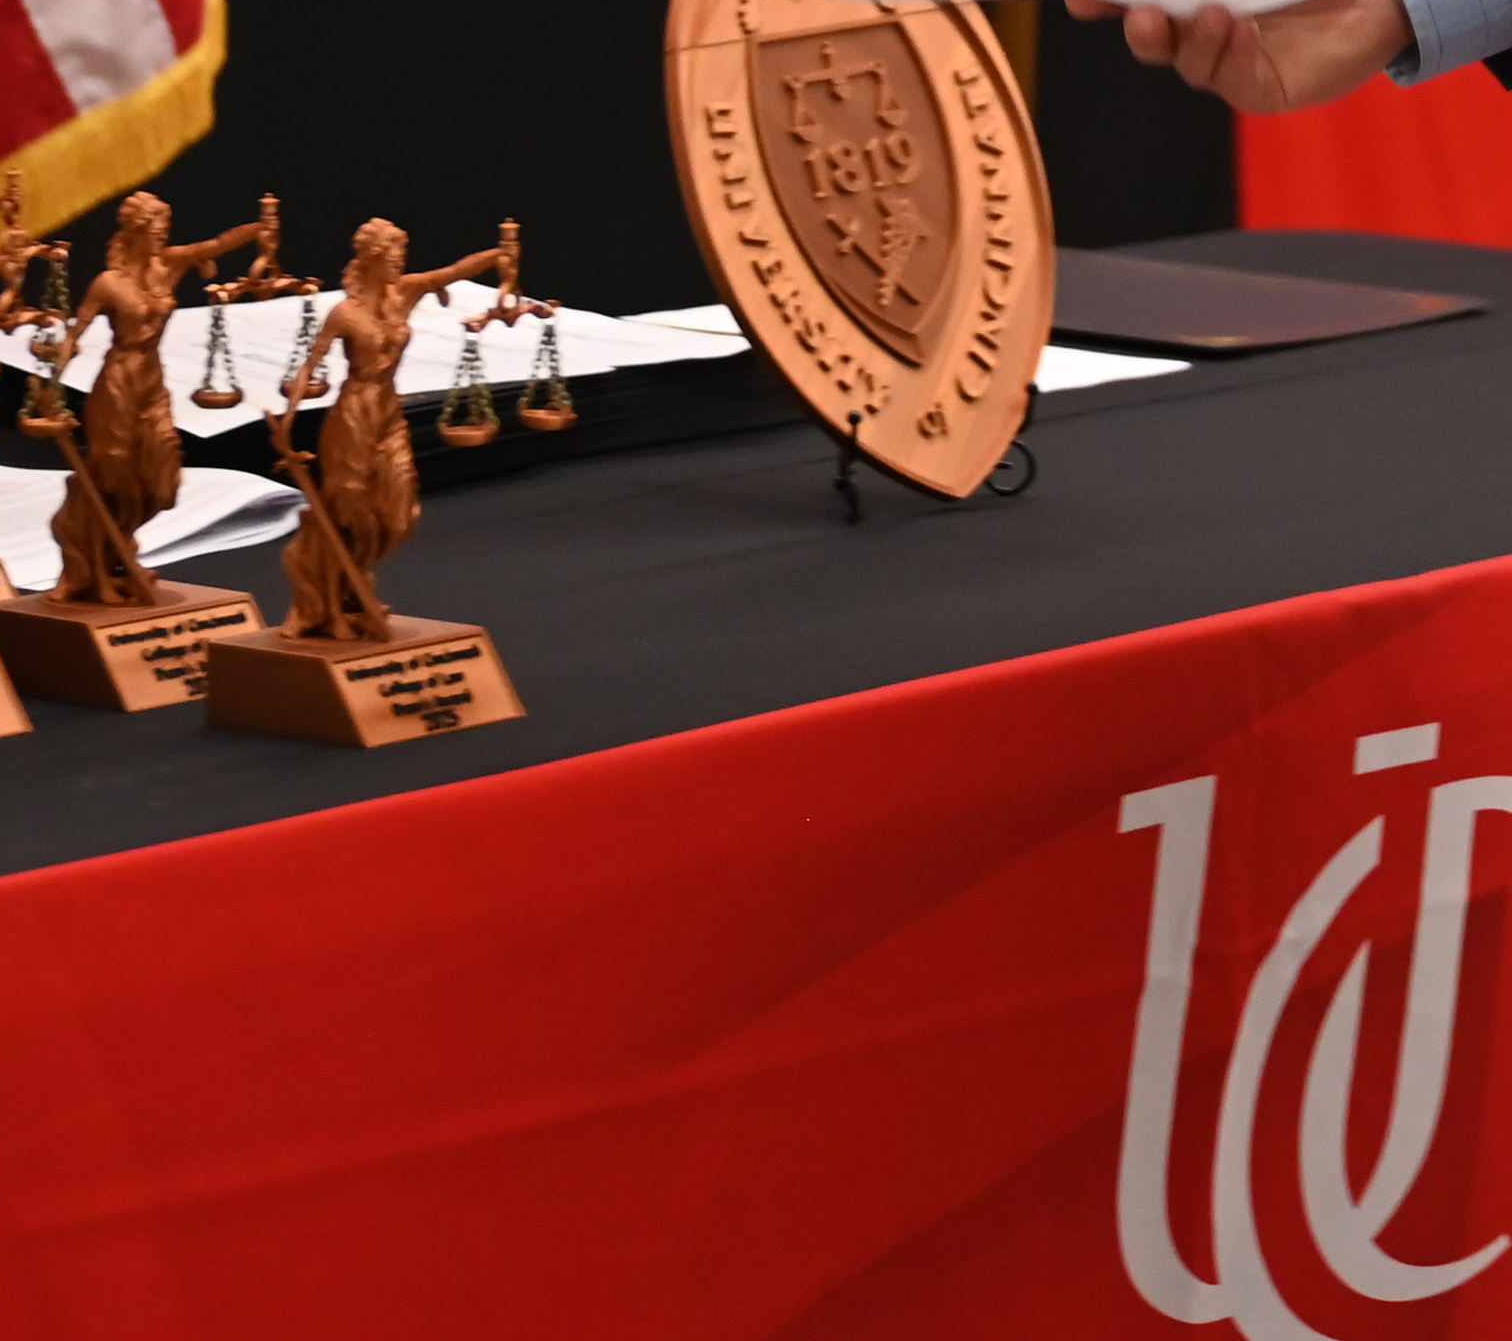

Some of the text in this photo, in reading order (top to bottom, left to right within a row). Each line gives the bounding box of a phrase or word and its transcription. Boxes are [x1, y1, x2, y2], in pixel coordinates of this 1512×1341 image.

[705, 105, 892, 417] UNIVERSITY
[954, 67, 1015, 405] CINCINNATI
[804, 133, 914, 202] 1819
